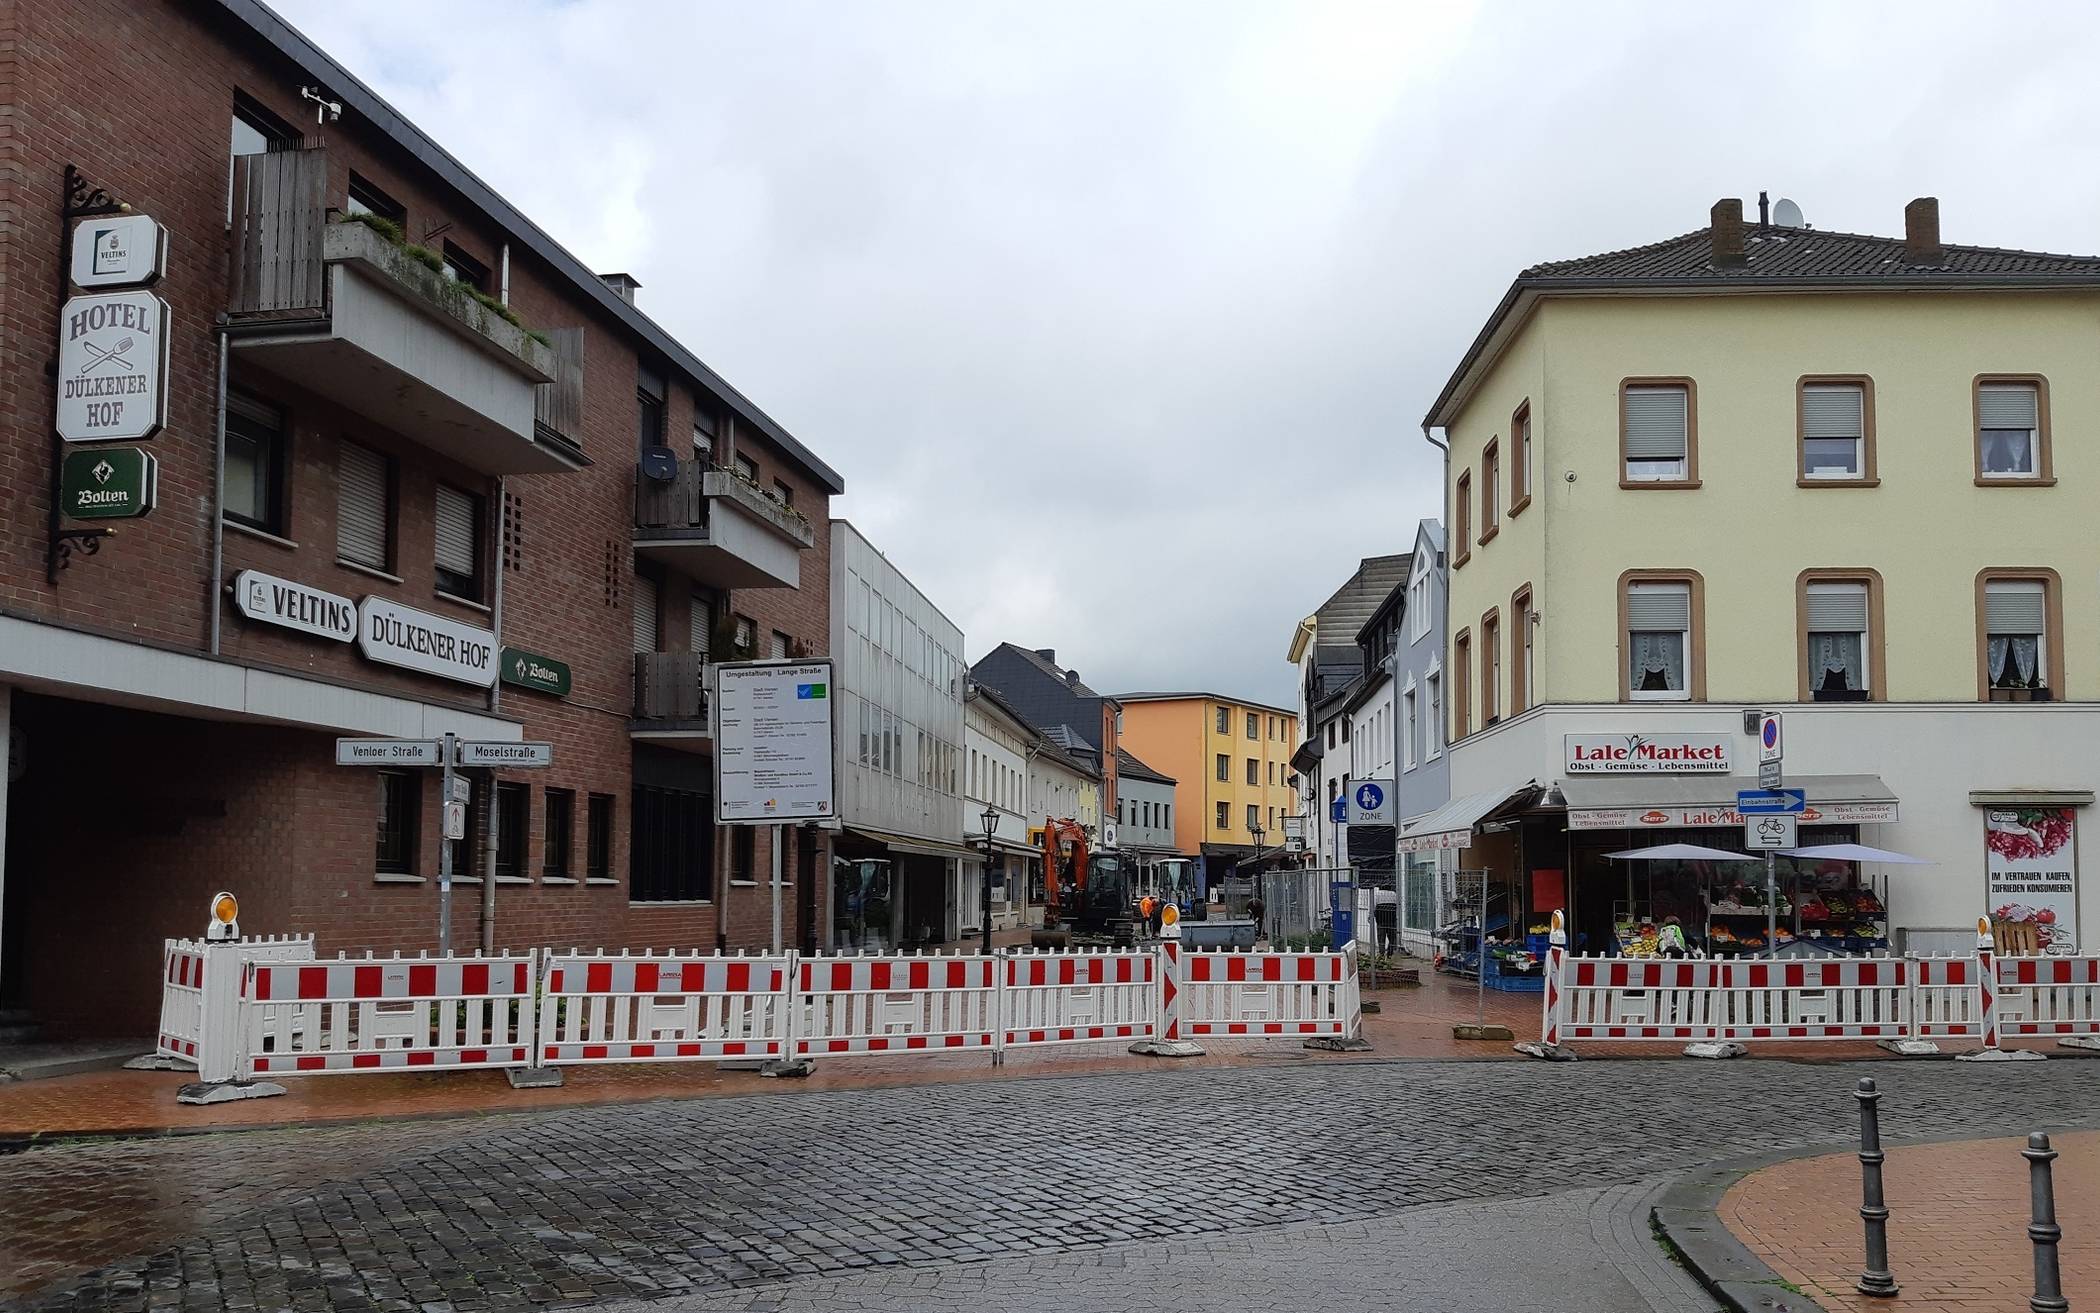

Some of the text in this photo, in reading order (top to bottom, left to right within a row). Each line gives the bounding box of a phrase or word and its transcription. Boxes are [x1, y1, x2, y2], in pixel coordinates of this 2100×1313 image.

[101, 250, 127, 259] VELTINS
[70, 303, 150, 341] HOTEL
[65, 375, 147, 399] DÜLKENER
[86, 402, 123, 427] HOF
[77, 490, 129, 505] Bolten
[272, 585, 350, 633] VELTINS
[371, 613, 490, 670] DÜLKENER HOF
[726, 667, 822, 679] Umgestaltung Lange Straße
[352, 745, 423, 757] Venloer Straße
[475, 746, 536, 758] Moselstraße
[1575, 744, 1724, 760] Lale Market
[1570, 762, 1595, 770] Obst
[1605, 761, 1648, 770] Gemüse
[1658, 761, 1729, 770] Lebensmittel
[1360, 812, 1383, 821] ZONE
[1683, 812, 1716, 824] Lale
[1991, 872, 2001, 880] IM
[2005, 872, 2041, 881] VERTRAUEN
[1991, 884, 2073, 893] ZUFRIEDEN KONSUMIEREN
